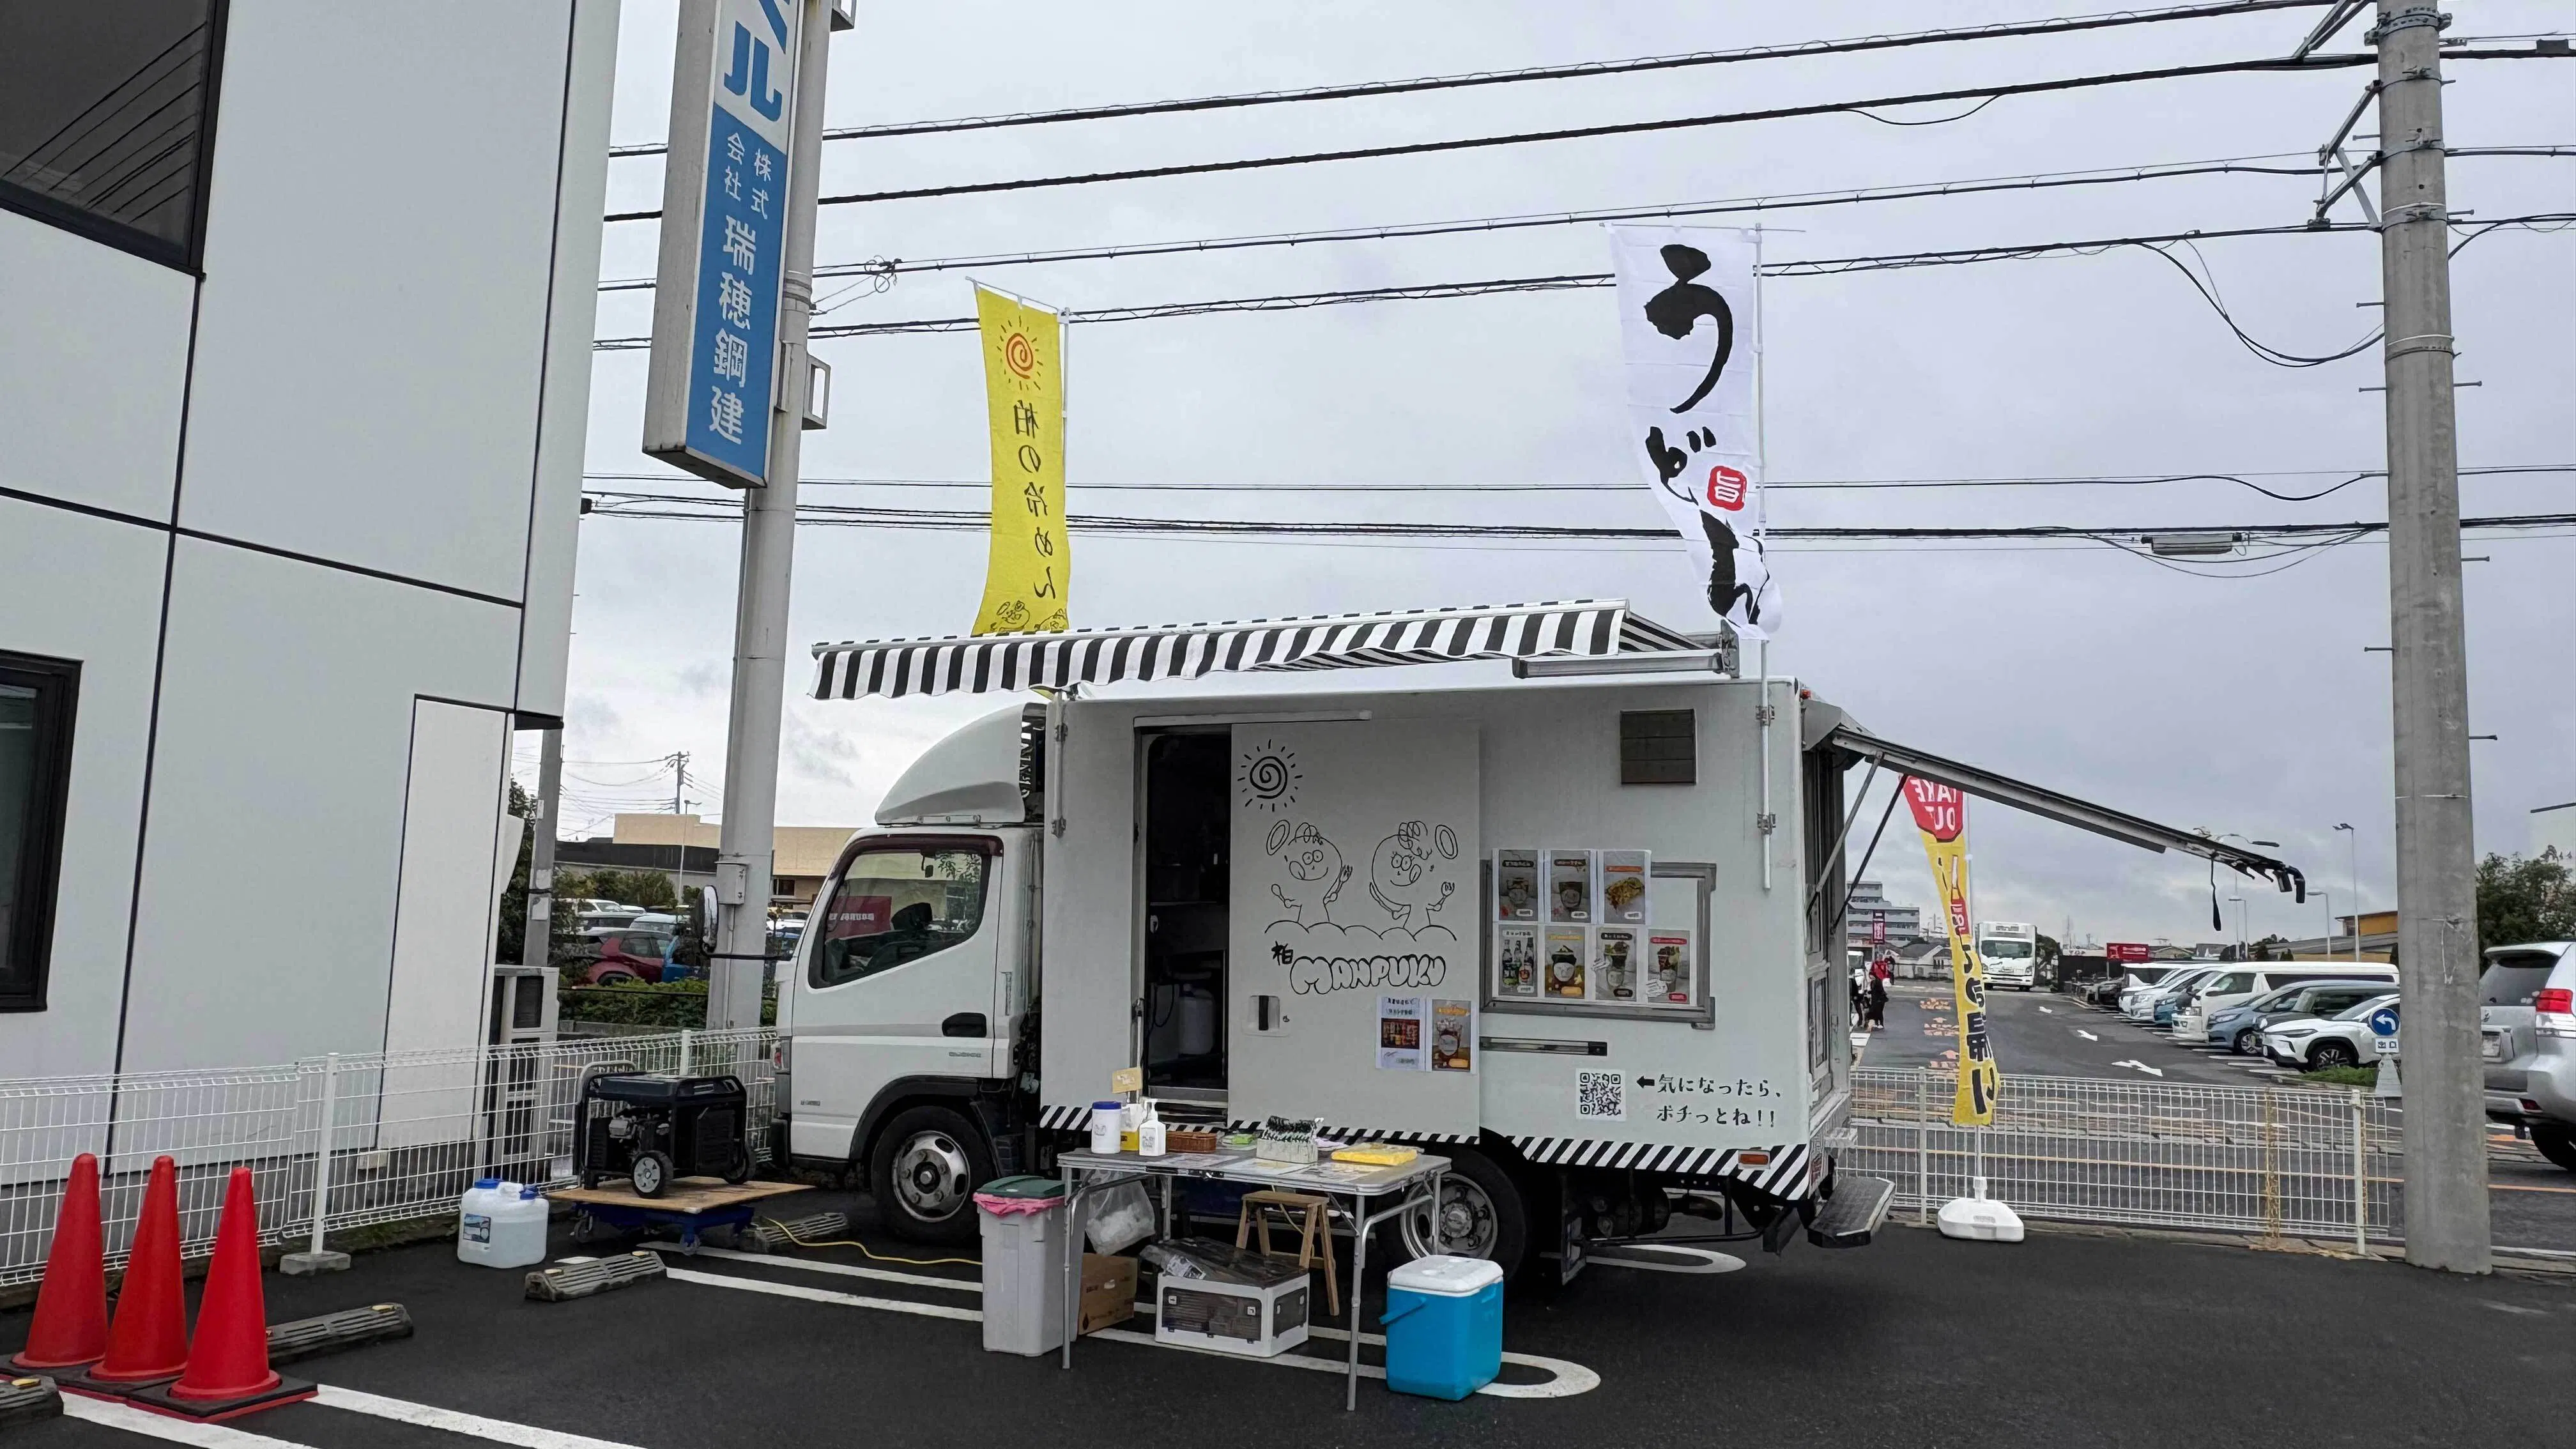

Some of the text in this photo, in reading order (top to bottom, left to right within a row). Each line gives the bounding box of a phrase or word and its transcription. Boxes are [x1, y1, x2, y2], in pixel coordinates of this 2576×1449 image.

[724, 0, 787, 122] ル
[724, 132, 746, 202] 会社
[751, 148, 772, 220] 株式
[709, 214, 757, 445] 瑞穂鋼建
[1271, 941, 1294, 966] 柏
[1290, 954, 1446, 995] MANPUKU
[1657, 1074, 1781, 1098] 気になったら、
